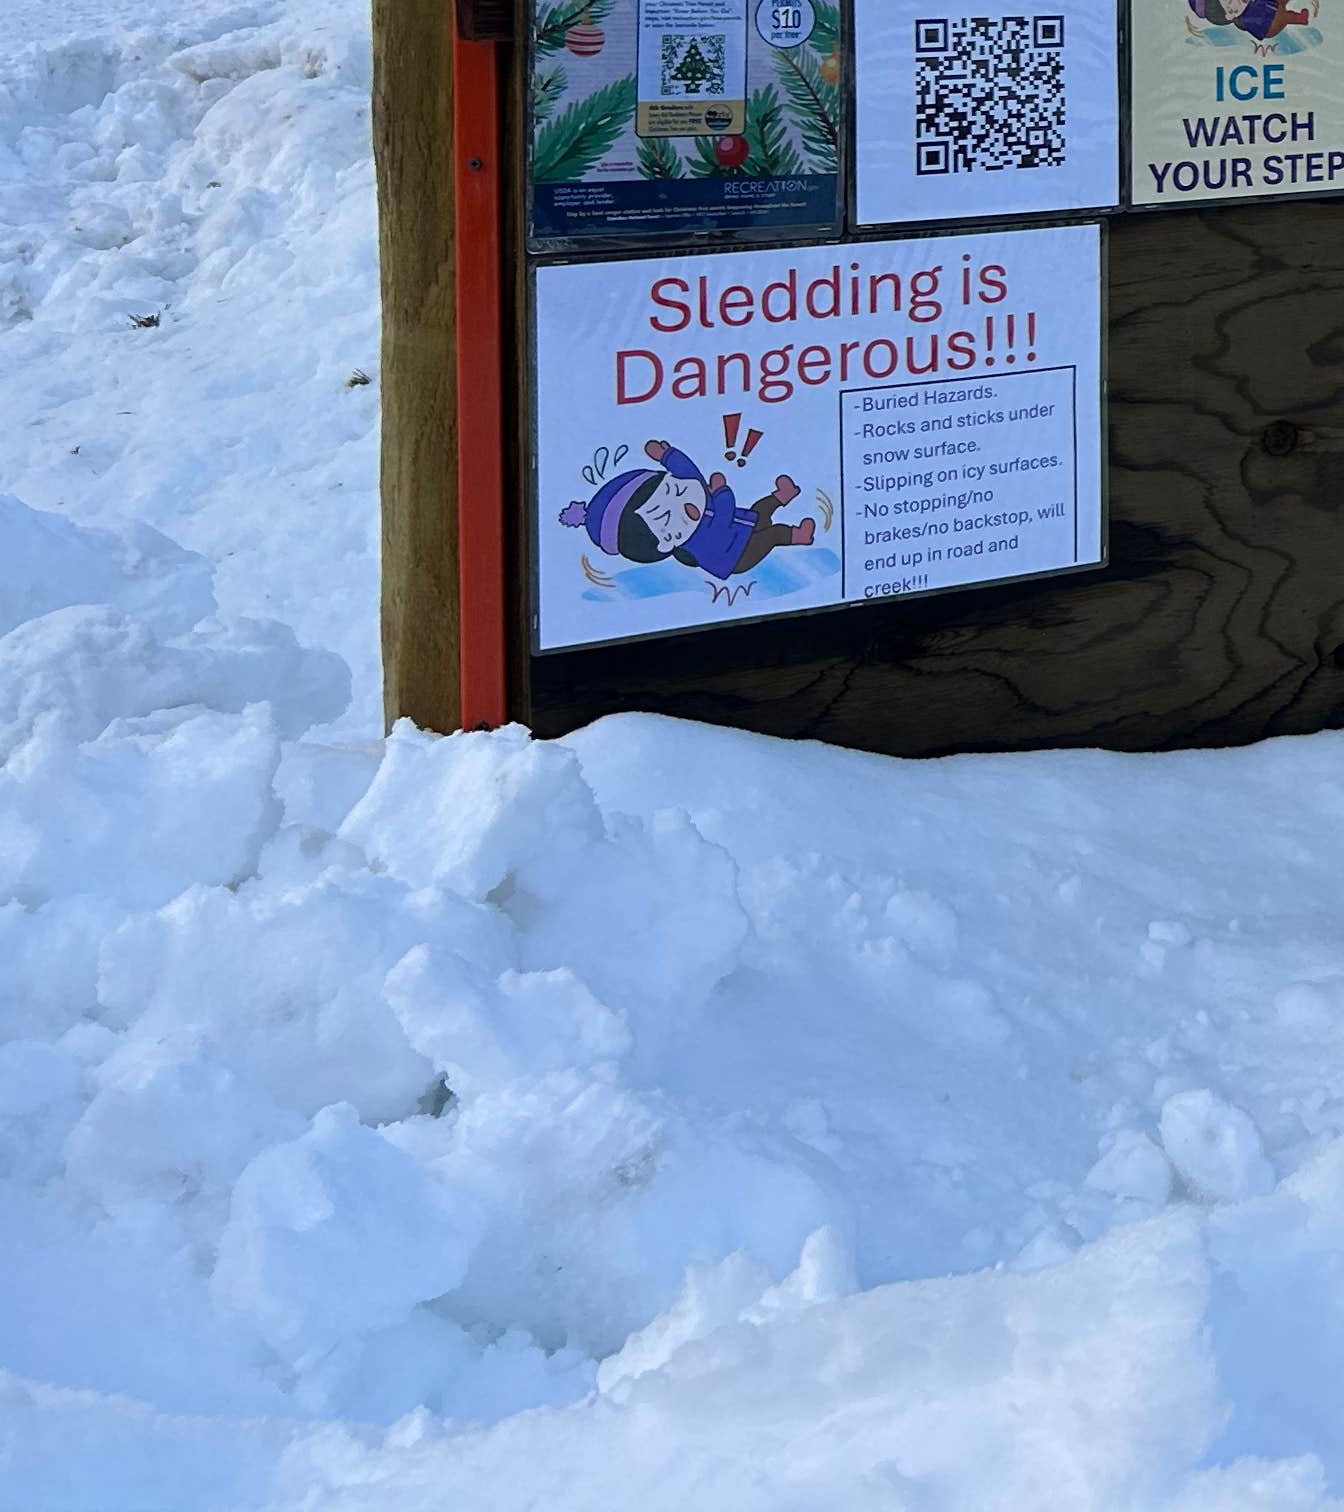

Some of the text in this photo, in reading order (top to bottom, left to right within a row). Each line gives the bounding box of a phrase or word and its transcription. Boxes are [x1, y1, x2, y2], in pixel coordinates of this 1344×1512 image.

[1216, 64, 1285, 102] ICE
[1183, 112, 1315, 148] WATCH
[1149, 158, 1252, 193] YOUR
[649, 254, 1008, 333] Sledding is
[616, 312, 1039, 406] Dangerous!!!
[925, 386, 998, 406] Hazards.
[920, 416, 952, 432] and
[957, 409, 1004, 426] sticks
[1009, 404, 1055, 421] under
[863, 440, 981, 465] snow surface.
[938, 470, 958, 482] on
[962, 464, 985, 480] icy
[989, 455, 1063, 475] surfaces.
[893, 490, 994, 515] stopping/no
[865, 503, 1065, 545] brakes/no backstop, will
[865, 536, 1018, 571] end up in road and
[864, 575, 929, 598] creek!!!
